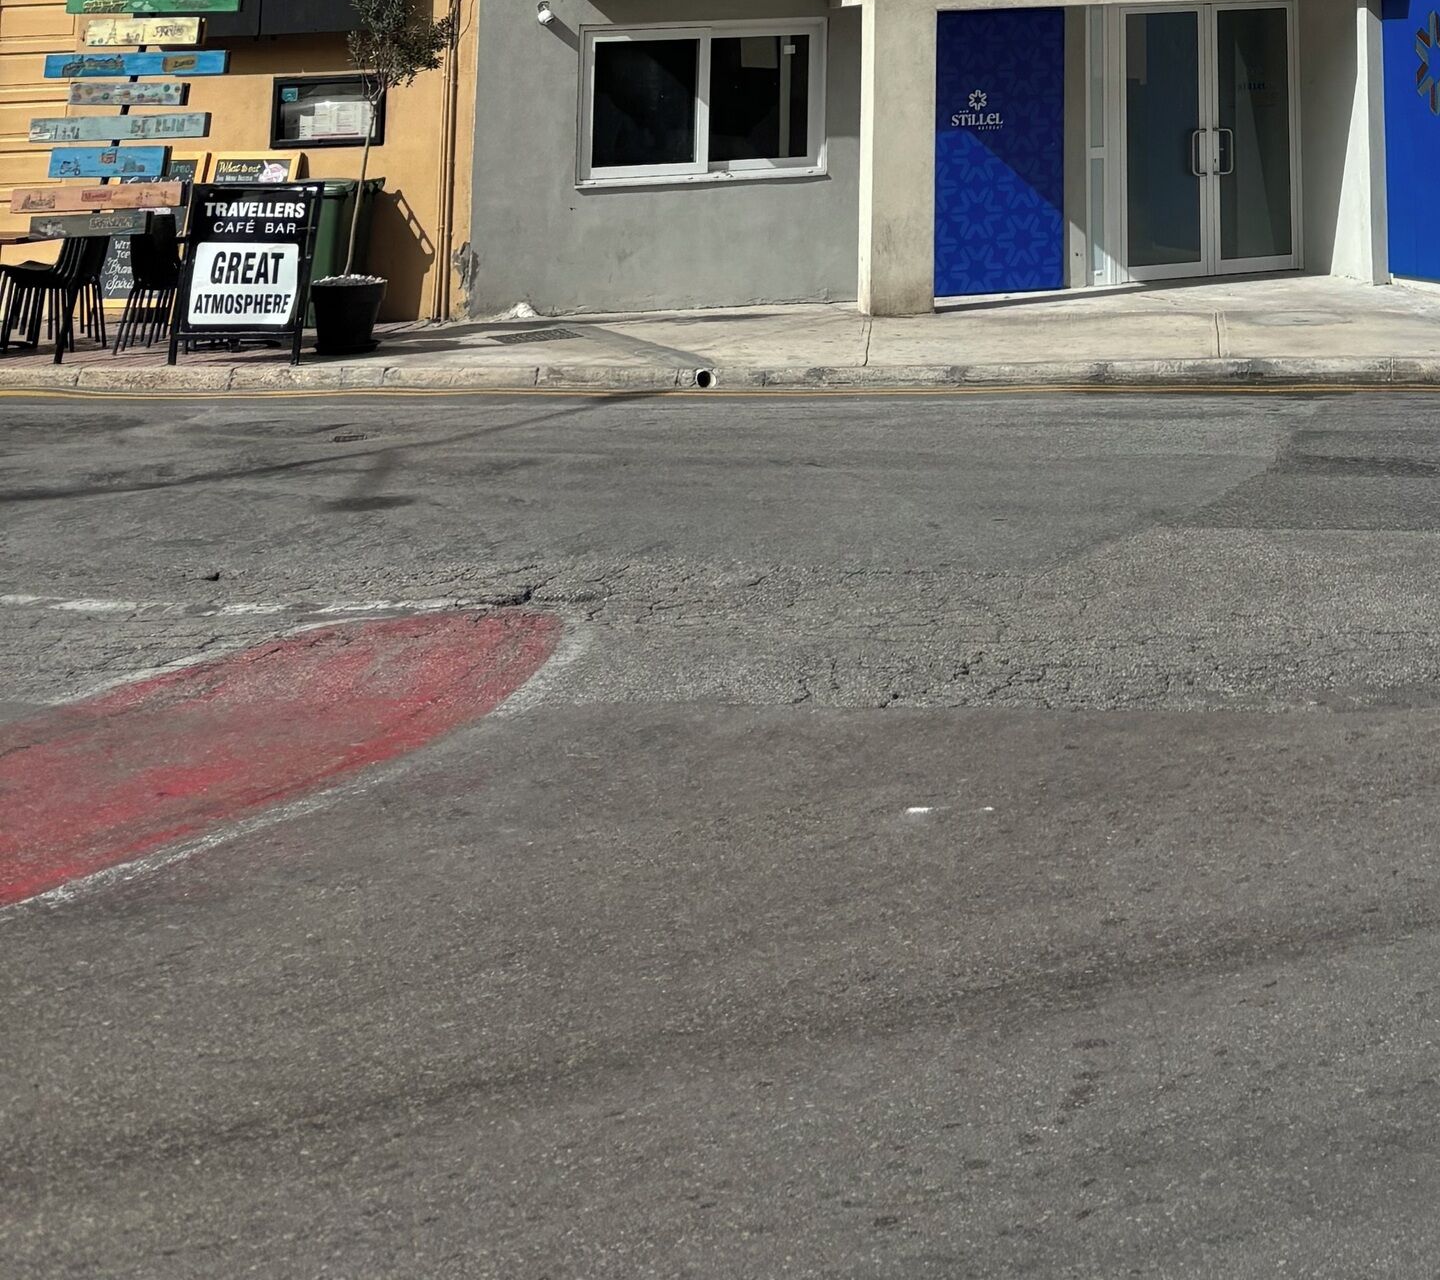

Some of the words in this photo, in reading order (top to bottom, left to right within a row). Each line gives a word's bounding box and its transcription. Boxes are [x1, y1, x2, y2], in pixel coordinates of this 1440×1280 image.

[204, 201, 306, 219] TRAVELLERS
[213, 219, 255, 234] CAFÉ
[265, 222, 297, 234] BAR
[210, 251, 284, 285] GREAT
[193, 293, 291, 315] ATMOSPHERE
